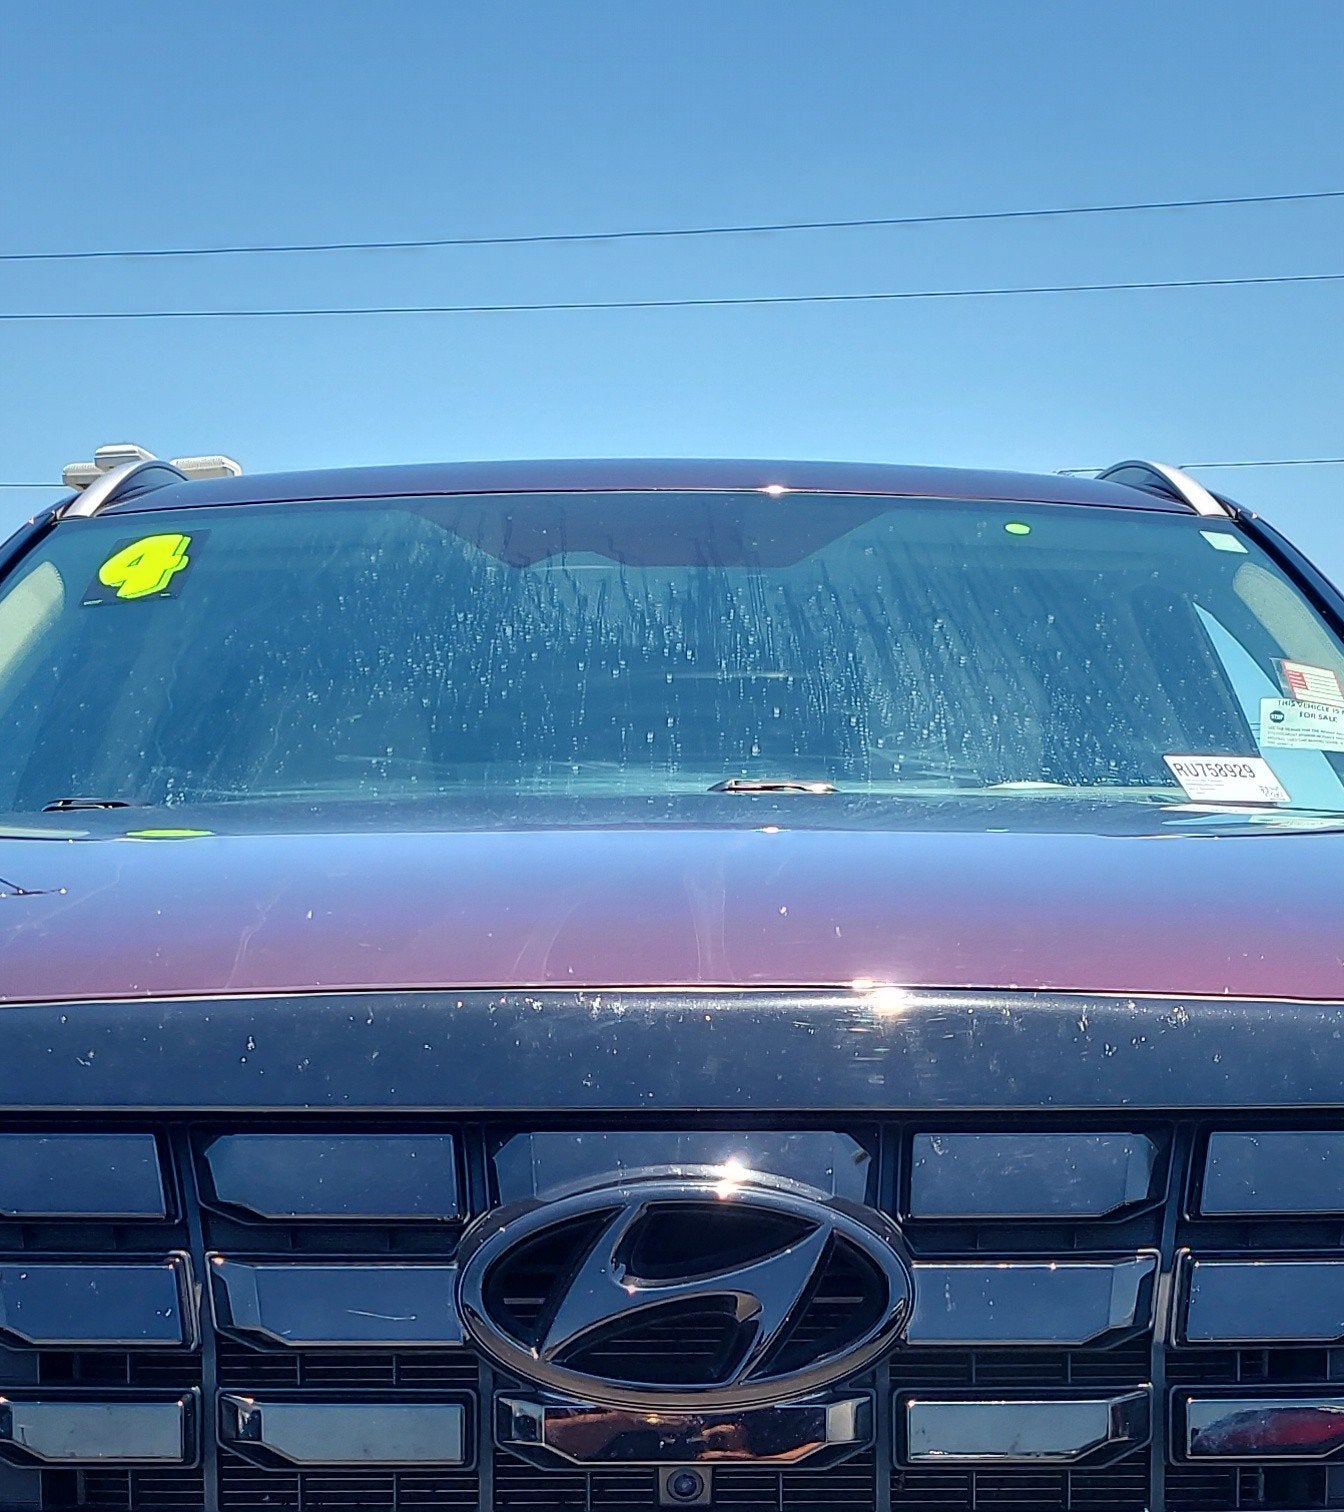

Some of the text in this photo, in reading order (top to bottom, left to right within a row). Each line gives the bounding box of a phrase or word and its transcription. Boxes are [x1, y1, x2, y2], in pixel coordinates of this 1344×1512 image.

[98, 533, 192, 599] 4
[1297, 701, 1329, 713] VEHICLE
[1299, 711, 1338, 723] FOR SALE
[1173, 763, 1256, 778] RU758929
